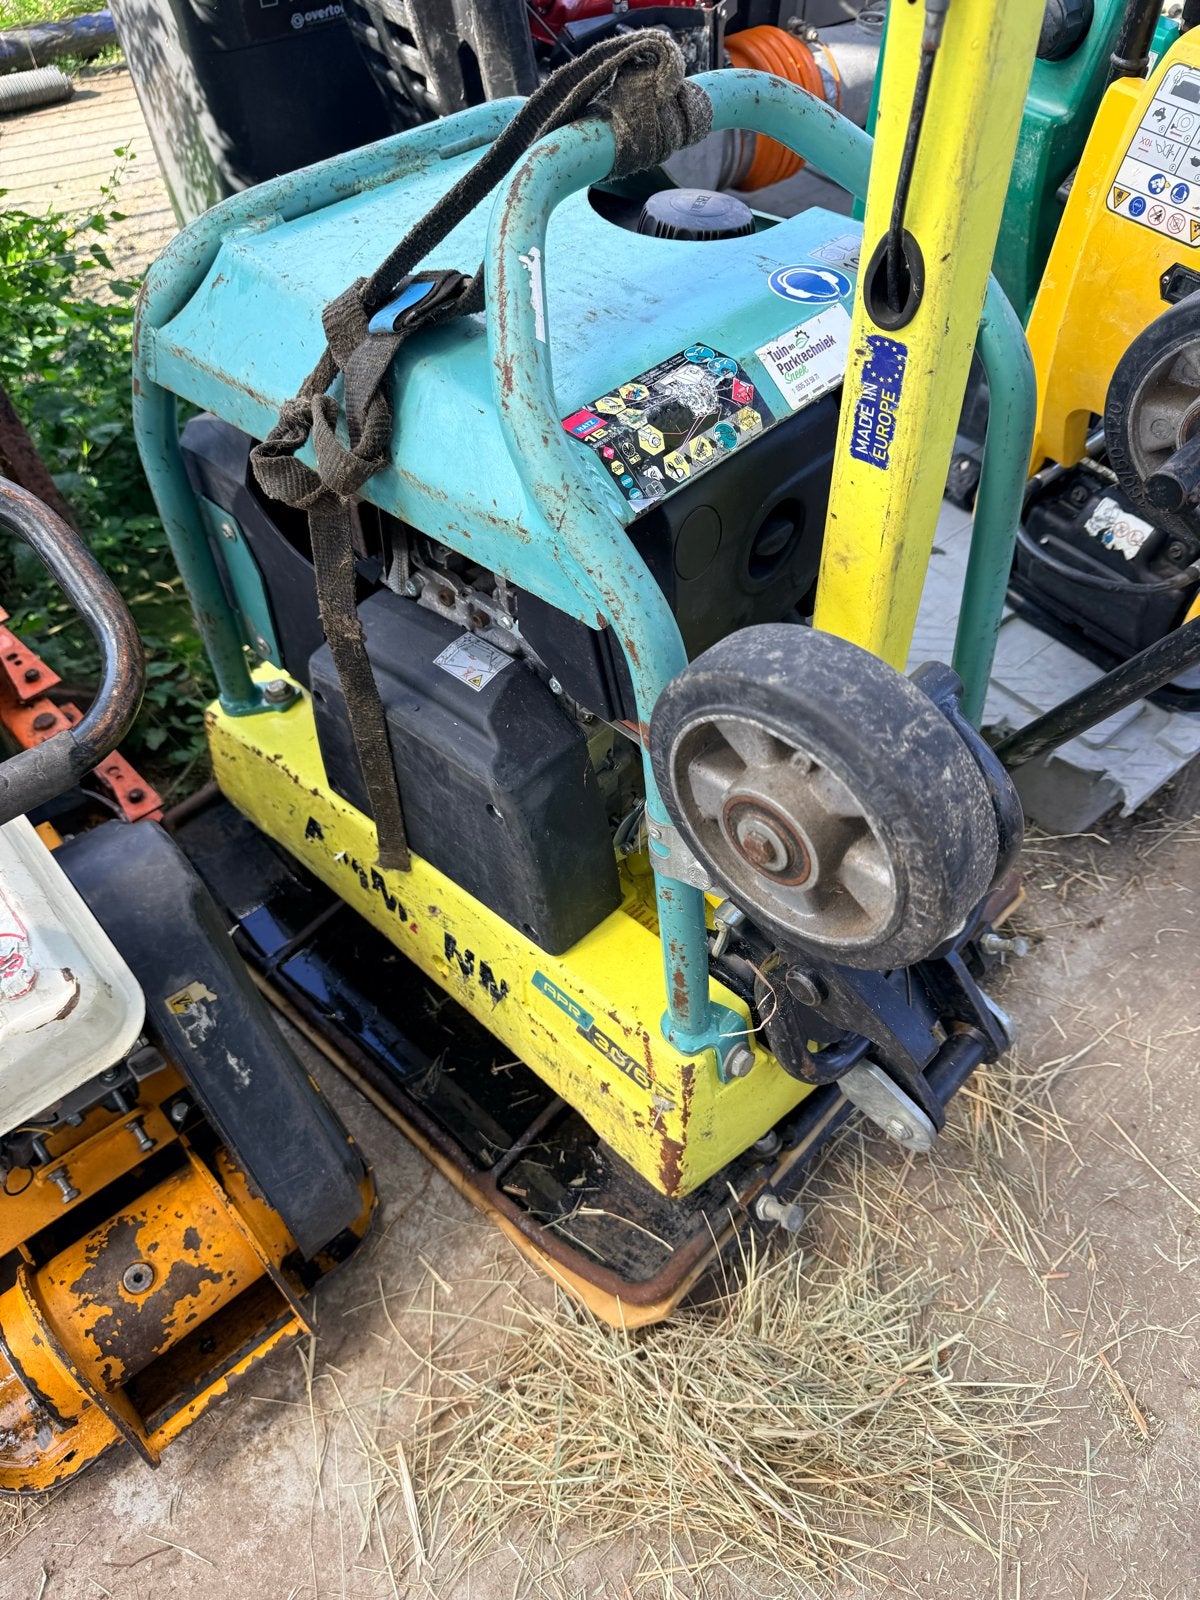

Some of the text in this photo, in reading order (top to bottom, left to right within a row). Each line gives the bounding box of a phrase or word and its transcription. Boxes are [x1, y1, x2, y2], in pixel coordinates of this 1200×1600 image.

[304, 4, 344, 21] overto
[767, 344, 789, 364] Tuin
[776, 334, 836, 375] Parktechniek
[784, 366, 808, 385] Sneek
[576, 420, 595, 432] HATZ
[855, 382, 878, 454] MADE IN
[872, 389, 896, 460] EUROPE
[542, 983, 581, 1018] APR
